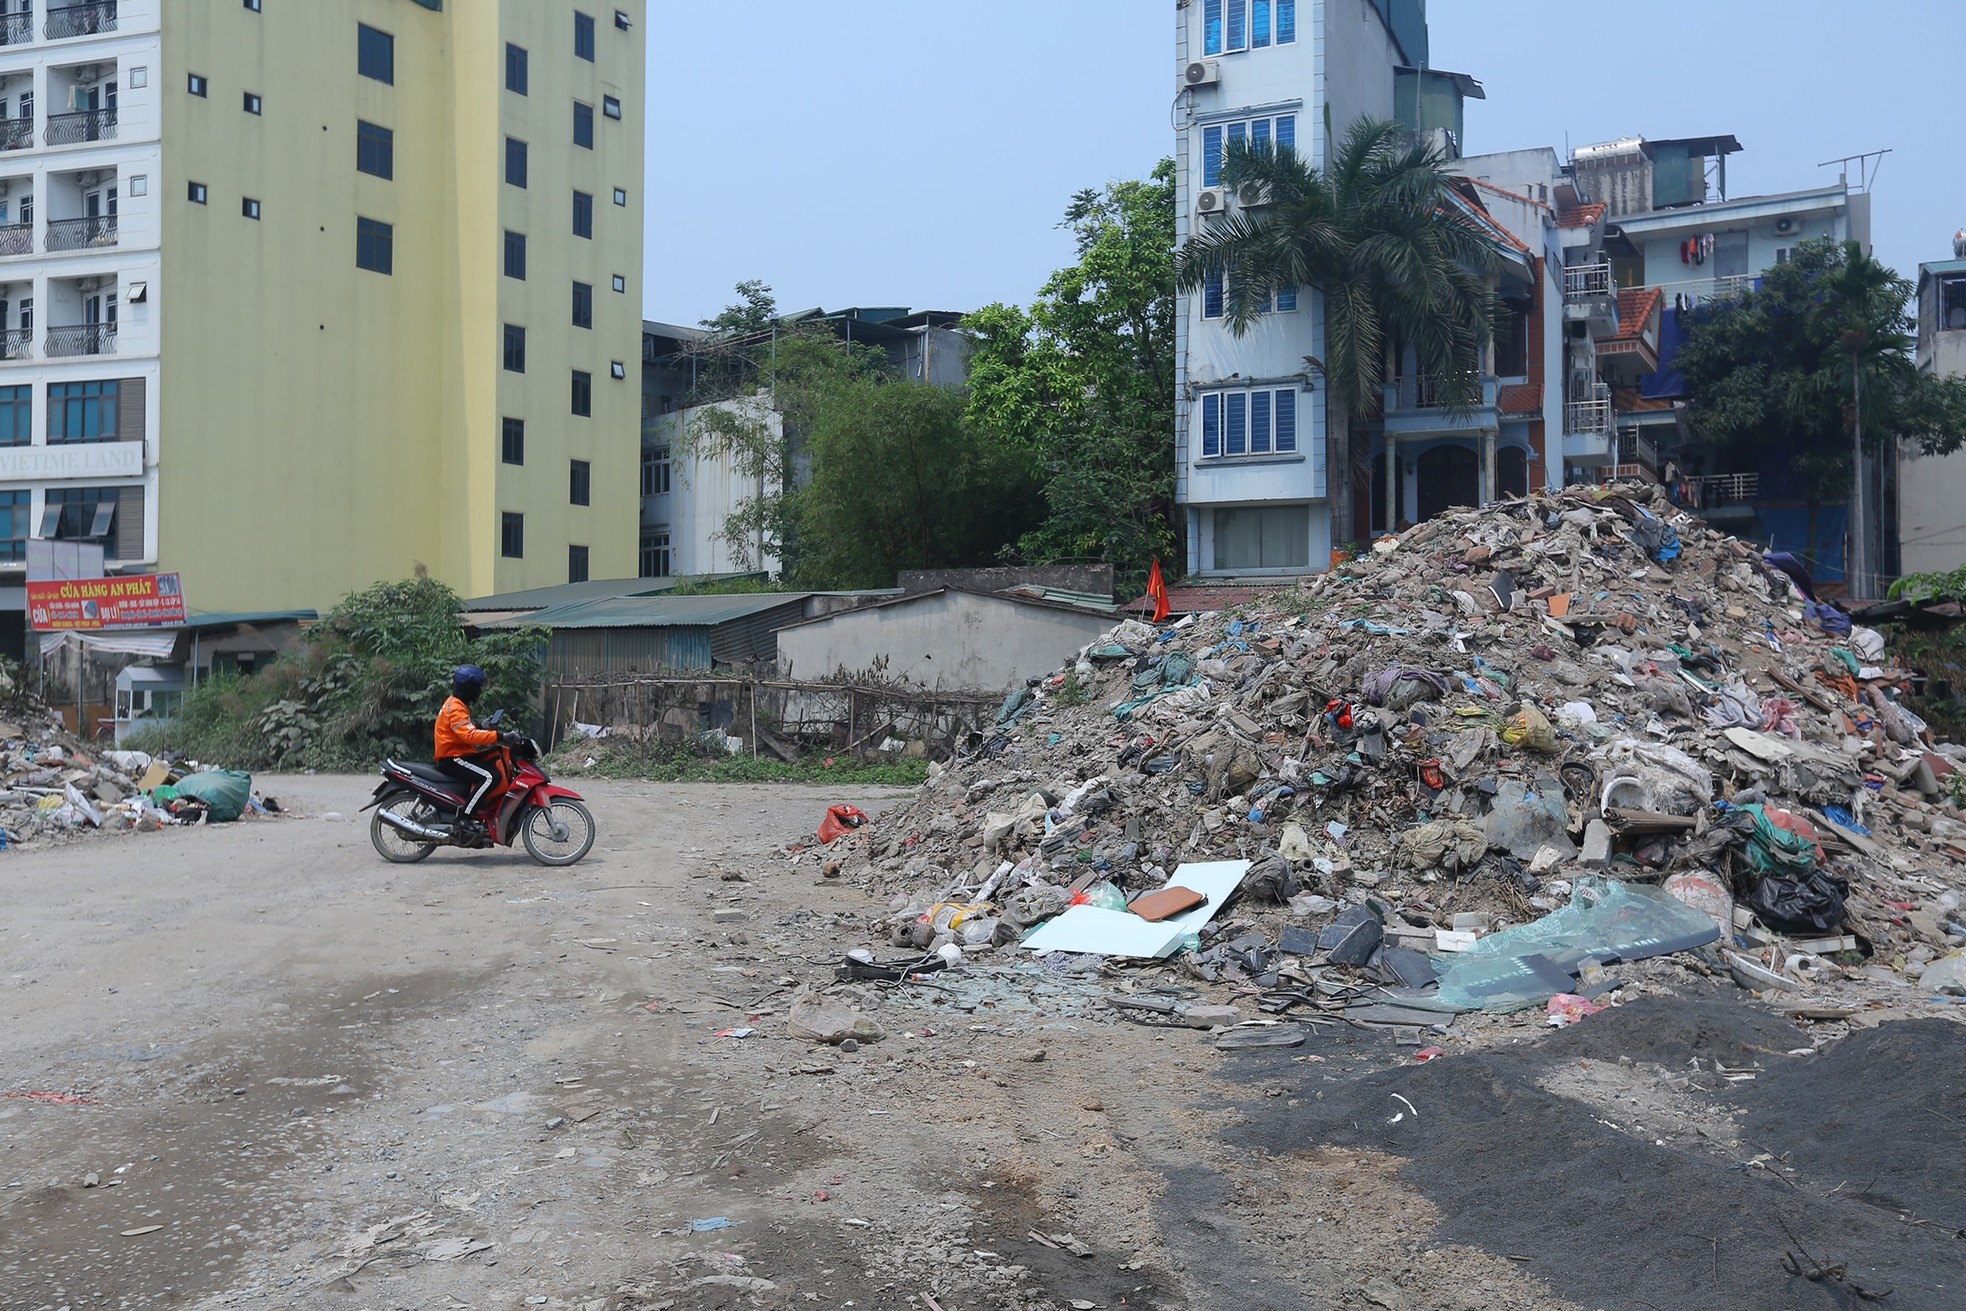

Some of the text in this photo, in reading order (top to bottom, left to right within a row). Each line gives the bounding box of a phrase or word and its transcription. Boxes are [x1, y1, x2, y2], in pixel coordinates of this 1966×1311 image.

[84, 450, 136, 469] LAND
[60, 581, 80, 598] CỬA
[81, 581, 107, 598] HÀNG
[110, 583, 125, 596] AN
[126, 578, 152, 595] PHÁT
